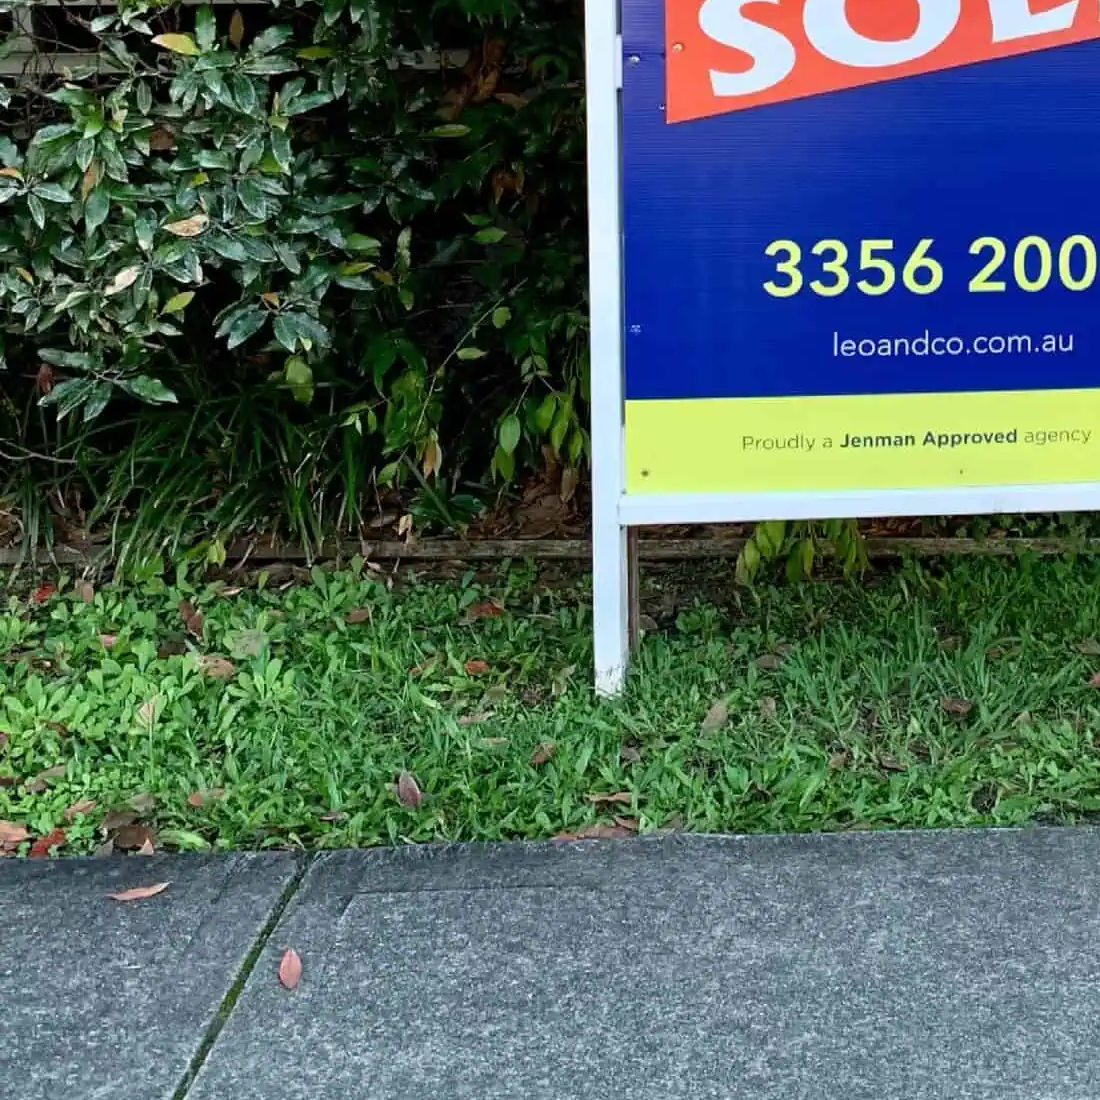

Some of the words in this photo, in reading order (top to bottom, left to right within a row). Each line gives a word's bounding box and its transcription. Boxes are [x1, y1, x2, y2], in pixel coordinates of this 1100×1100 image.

[762, 238, 944, 298] 3356
[833, 329, 1075, 357] leoandco.com.au
[741, 433, 816, 452] Proudly
[821, 438, 834, 449] a
[839, 432, 916, 449] Jenman
[922, 429, 1017, 448] Approved
[1023, 428, 1092, 445] agency
